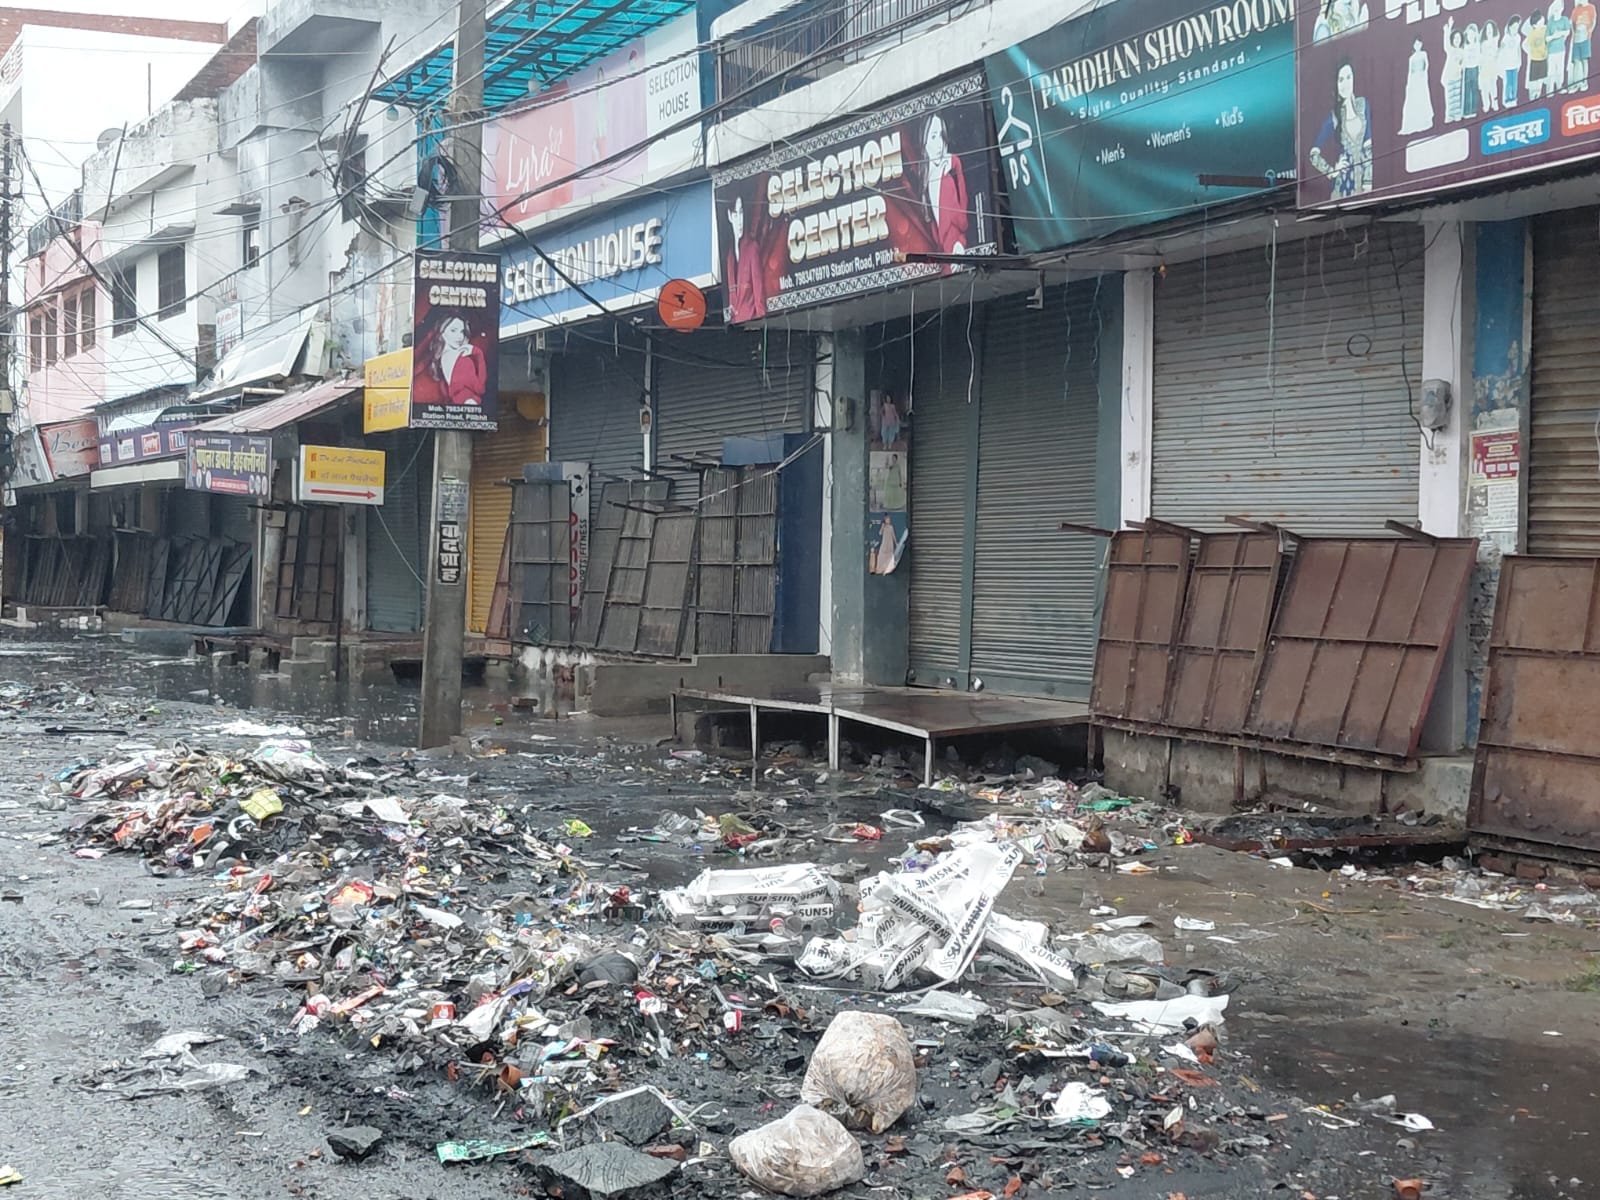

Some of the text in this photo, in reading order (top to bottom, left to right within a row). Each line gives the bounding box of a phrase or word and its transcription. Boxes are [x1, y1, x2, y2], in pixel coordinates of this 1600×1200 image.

[1039, 0, 1296, 110] PARIDHAN SHOWROOM
[648, 57, 698, 96] SELECTION
[658, 92, 690, 121] HOUSE
[1101, 143, 1125, 166] Men's
[1151, 122, 1192, 149] Women's
[506, 133, 554, 213] Lyra
[768, 132, 904, 218] SELECTION
[788, 195, 890, 264] CENTER
[419, 258, 498, 284] SELECTION
[505, 217, 662, 305] SELECTION HOUSE
[831, 261, 854, 278] Station
[579, 518, 588, 559] FITNESS
